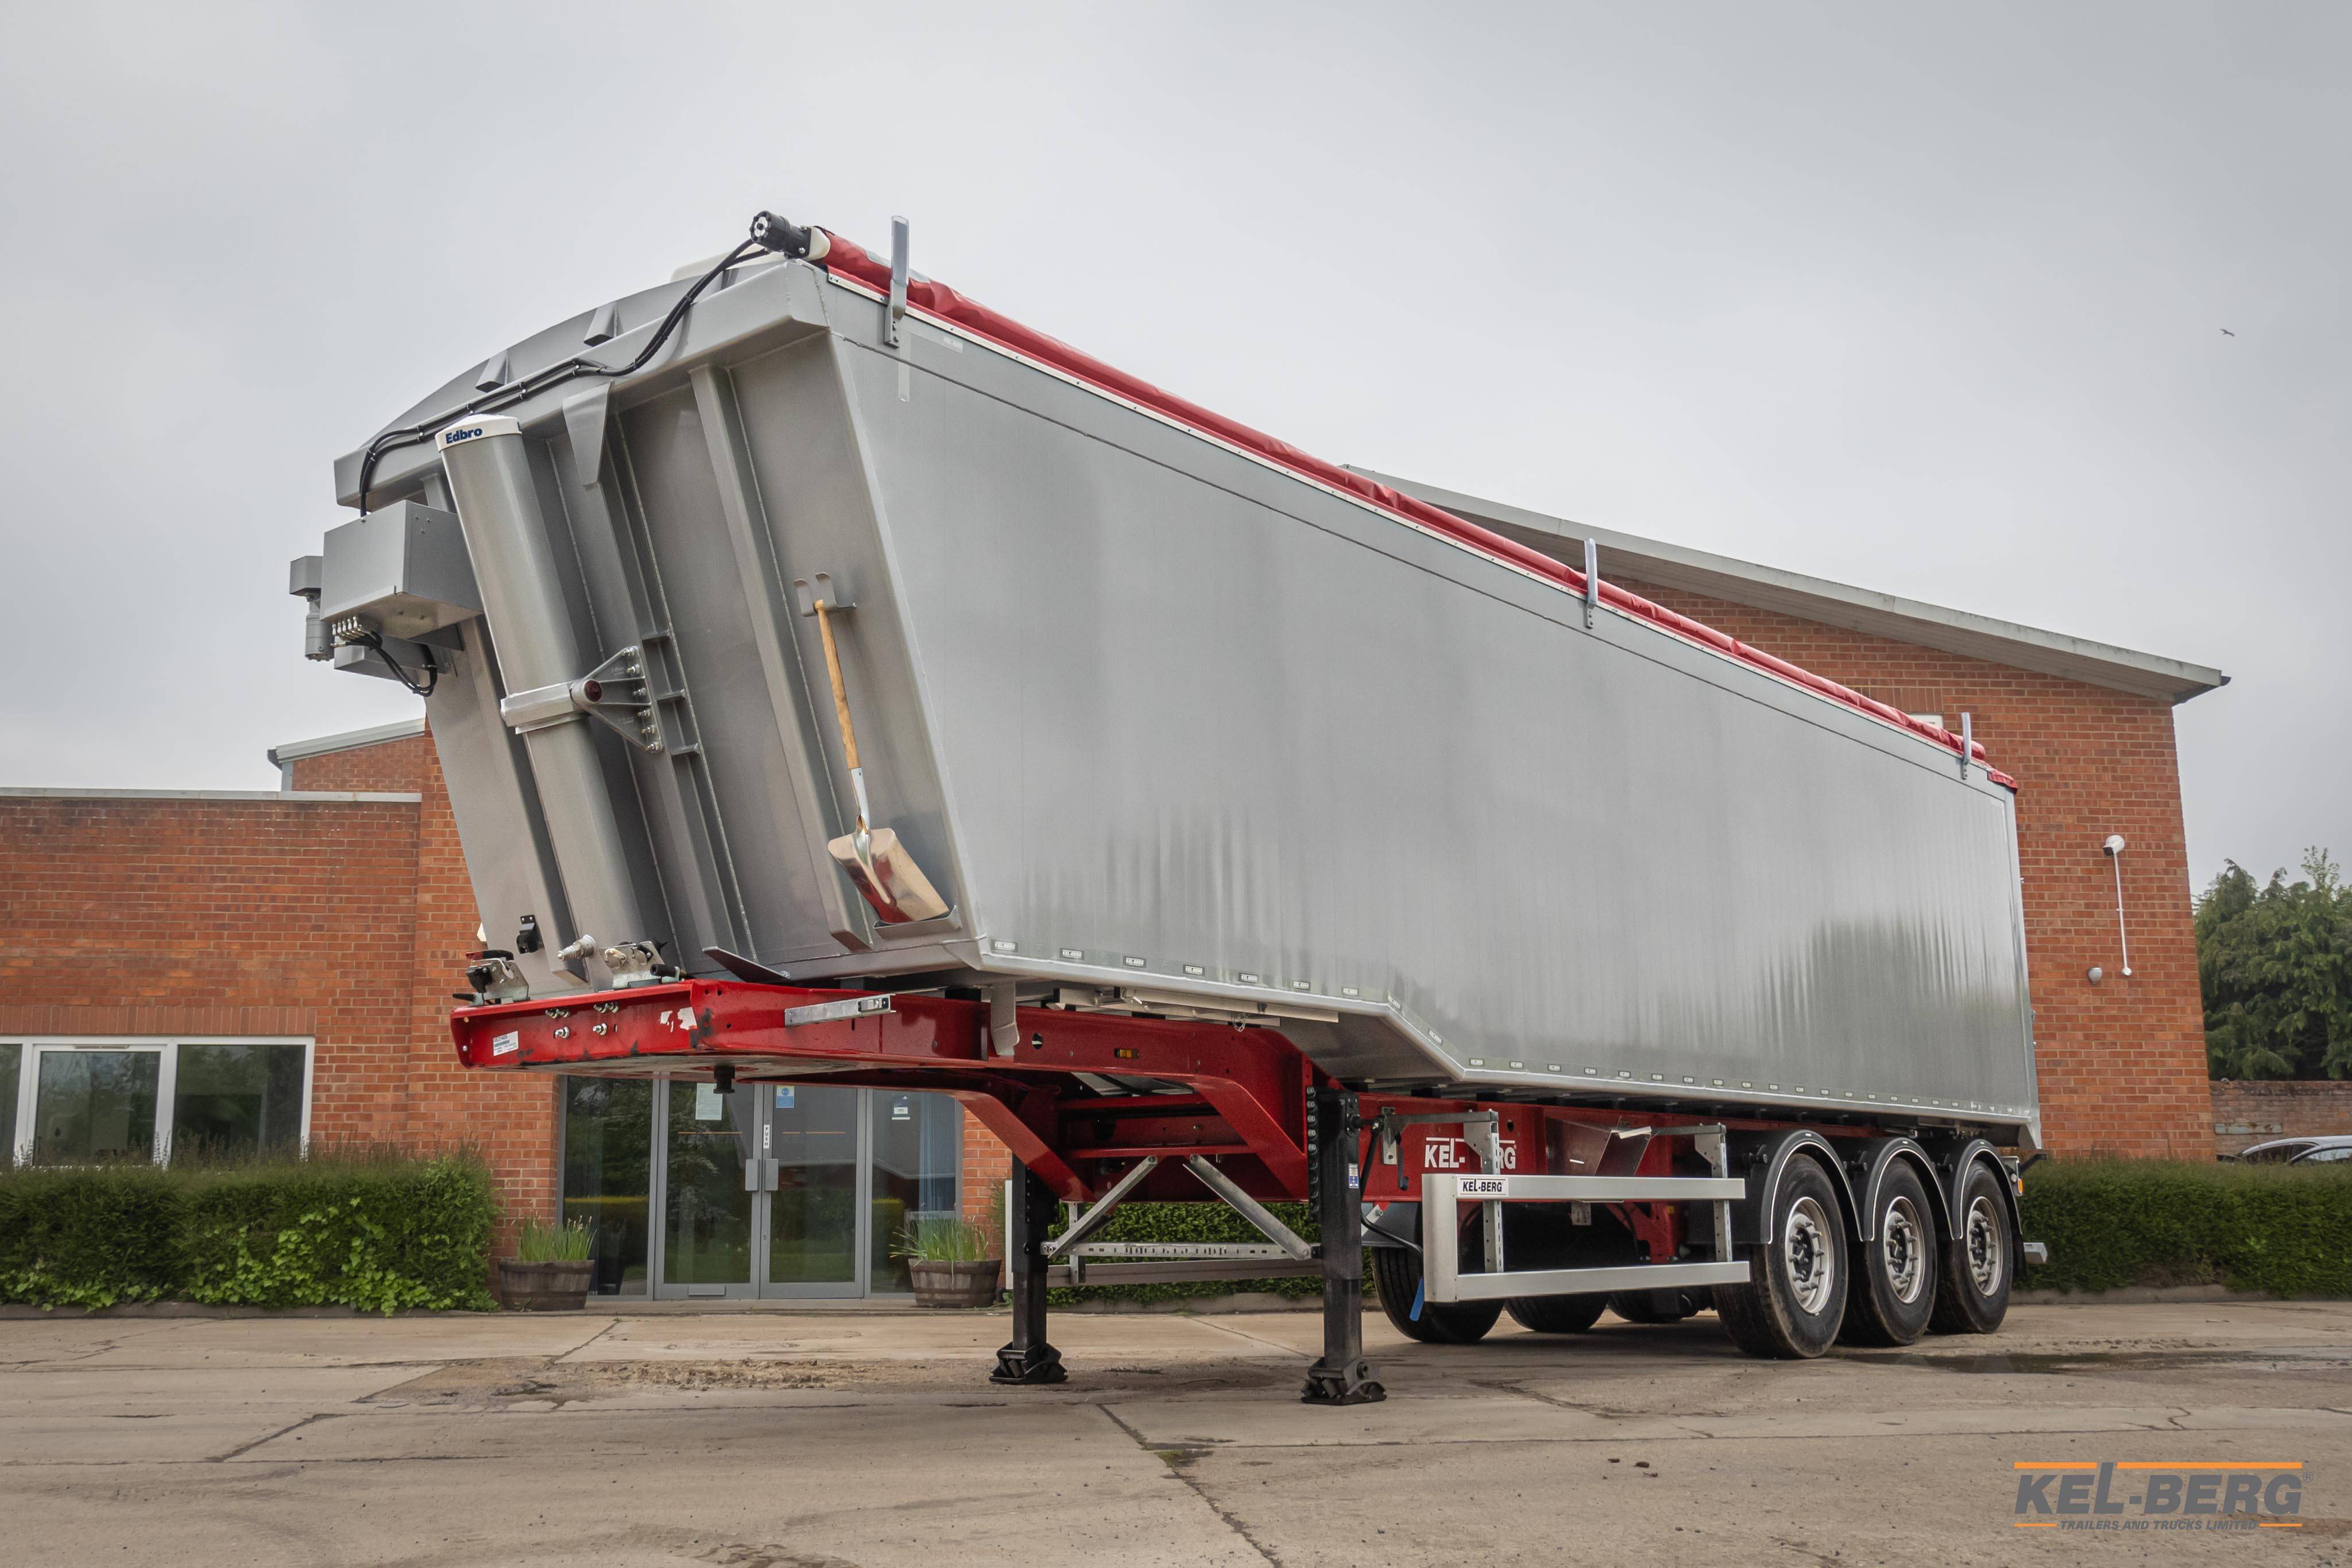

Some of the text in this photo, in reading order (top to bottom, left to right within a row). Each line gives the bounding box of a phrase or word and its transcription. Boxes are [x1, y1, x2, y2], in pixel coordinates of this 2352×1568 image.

[446, 428, 482, 444] Edbro
[1425, 1138, 1516, 1170] KEL-G
[1463, 1179, 1502, 1192] KEL-BERG
